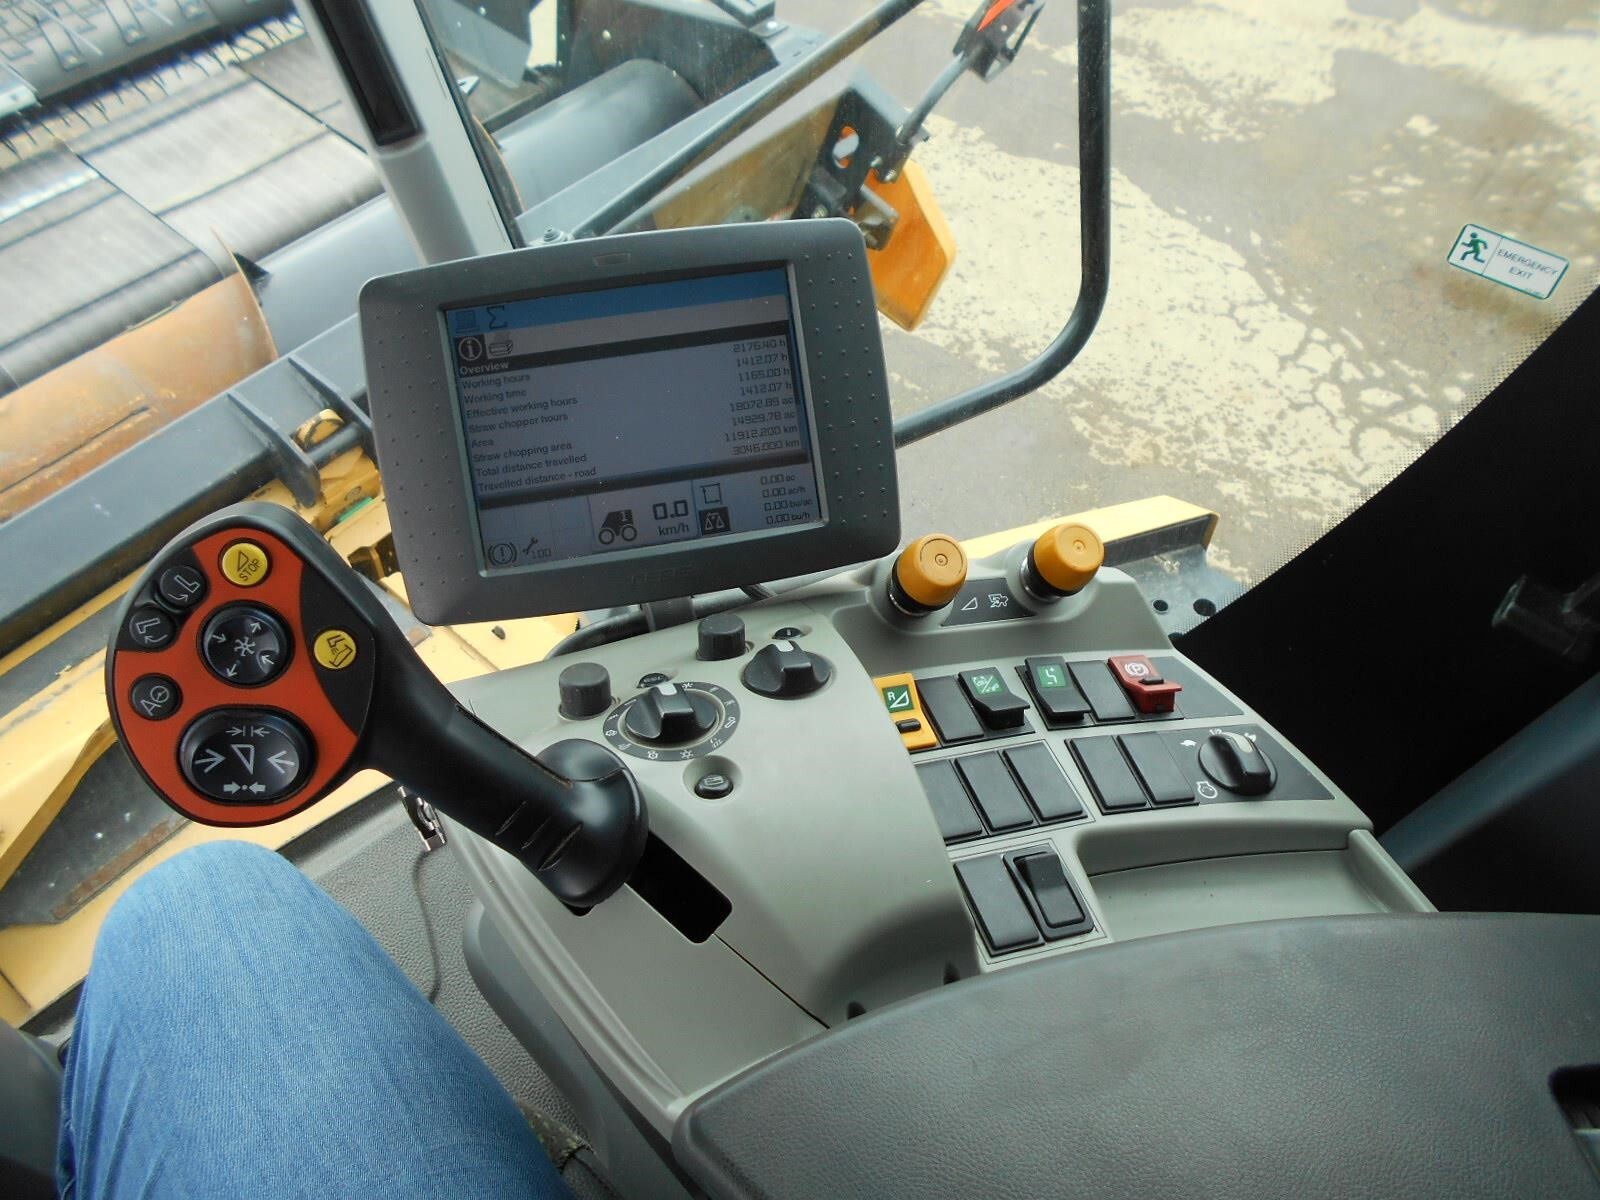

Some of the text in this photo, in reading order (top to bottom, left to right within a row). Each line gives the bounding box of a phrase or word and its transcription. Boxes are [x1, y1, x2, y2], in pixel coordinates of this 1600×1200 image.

[1497, 249, 1558, 276] EMERGENCY
[1508, 266, 1534, 280] EXIT
[459, 361, 509, 376] Overview
[462, 373, 530, 390] Working hours
[464, 388, 527, 405] Working time
[466, 396, 578, 419] Effective working hours
[469, 412, 569, 434] Straw chopper hours
[784, 425, 798, 434] km
[471, 438, 495, 449] Area
[473, 441, 573, 463] Straw chopping area
[786, 439, 800, 448] km
[476, 453, 587, 478] Total distance travelled
[478, 477, 522, 492] Travelled
[525, 471, 567, 485] distance
[574, 467, 597, 478] road
[760, 474, 785, 486] 0.00
[653, 499, 689, 521] 0.0
[766, 513, 790, 525] 0.00
[657, 522, 690, 538] km/h
[239, 558, 262, 582] STOP
[887, 690, 896, 701] R
[140, 699, 162, 717] A
